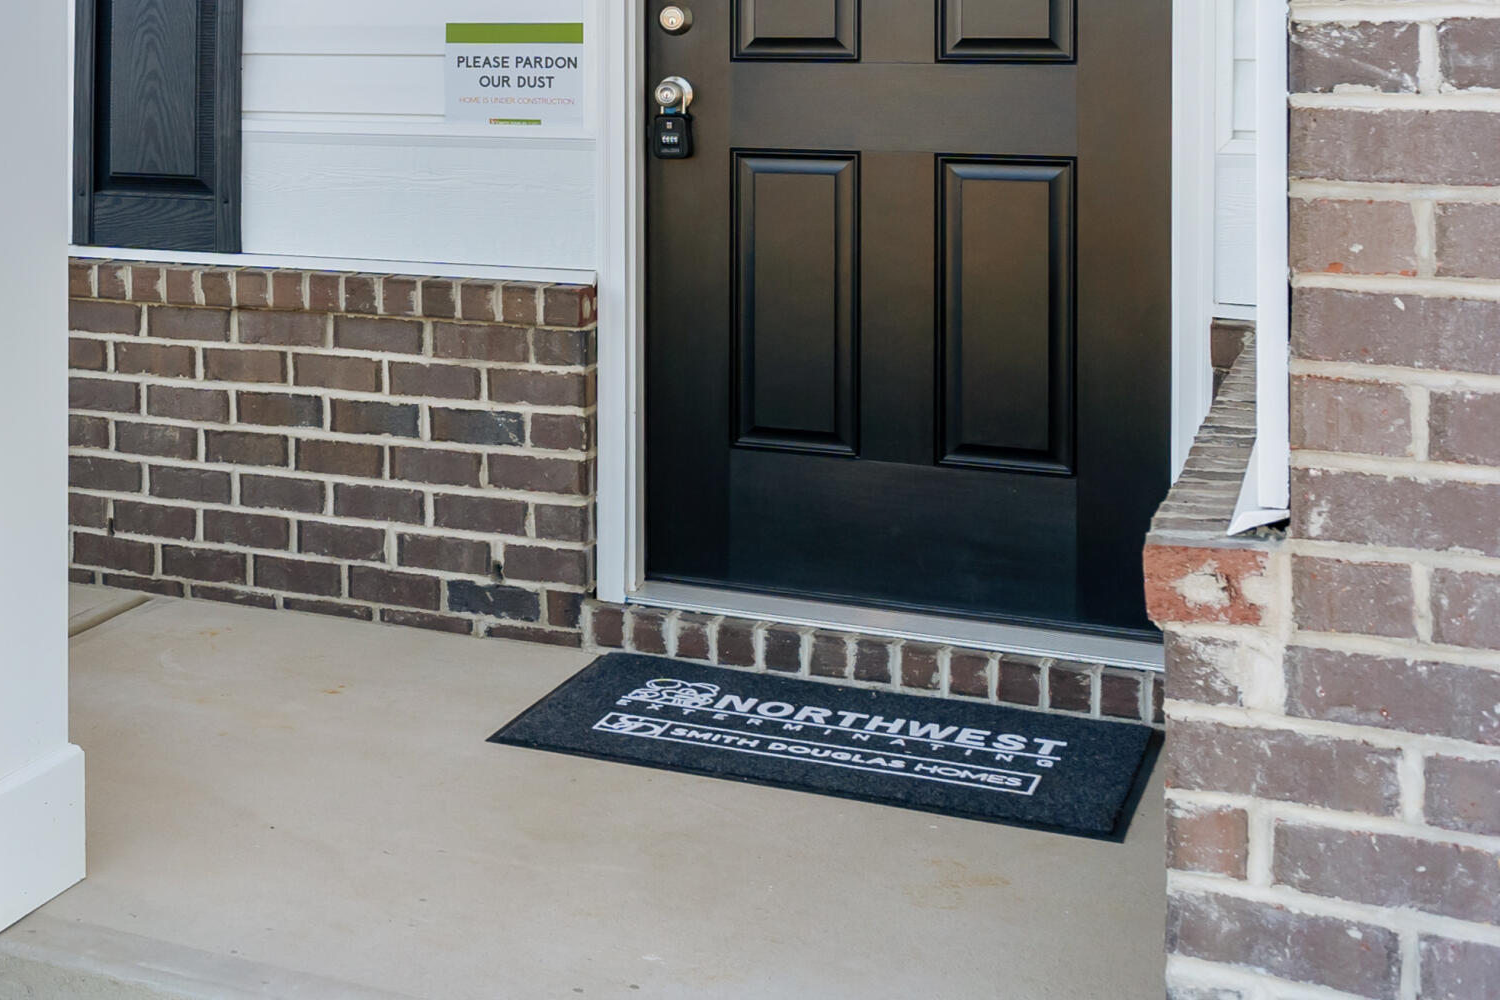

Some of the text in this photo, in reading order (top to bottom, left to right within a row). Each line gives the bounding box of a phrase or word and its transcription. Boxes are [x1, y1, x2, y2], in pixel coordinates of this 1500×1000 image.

[456, 55, 578, 69] PLEASE PARDON
[479, 75, 555, 88] OUR DUST
[459, 96, 575, 106] HOME IS UNDER CONSTRUCTION
[615, 698, 1054, 768] EXTERMINATING
[714, 694, 1068, 756] NORTHWEST
[670, 727, 1022, 787] SMITH DOUGLAS HOMES
